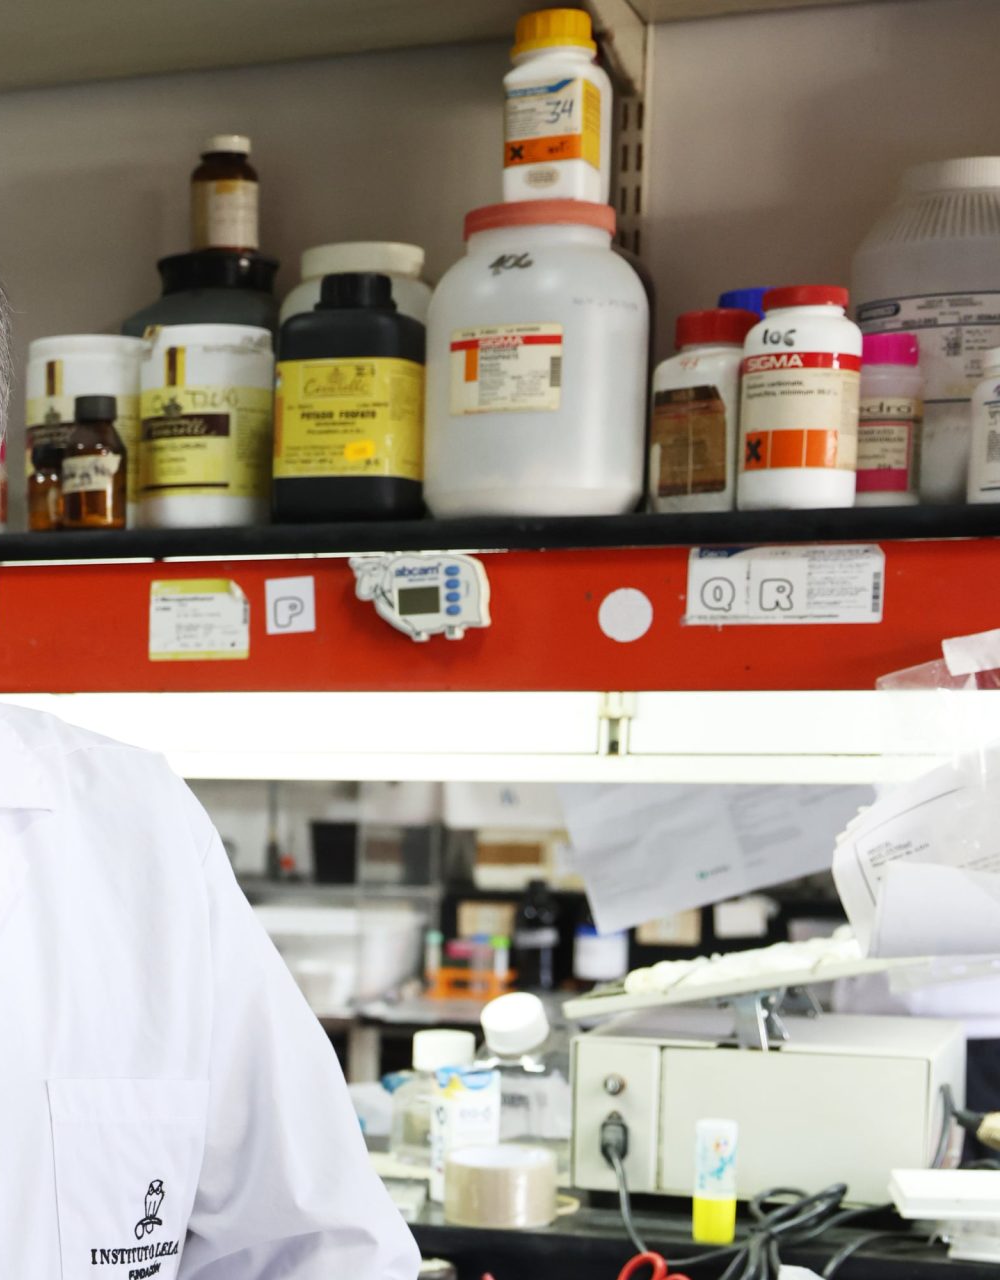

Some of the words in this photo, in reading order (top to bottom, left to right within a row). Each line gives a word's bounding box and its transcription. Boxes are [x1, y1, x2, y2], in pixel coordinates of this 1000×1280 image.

[545, 99, 573, 124] 34
[762, 328, 796, 347] 106
[747, 353, 803, 372] SIGMA
[395, 565, 439, 577] abcam
[700, 577, 736, 613] Q
[758, 577, 794, 612] R
[273, 596, 304, 629] P
[90, 1243, 155, 1265] INSTITUTO
